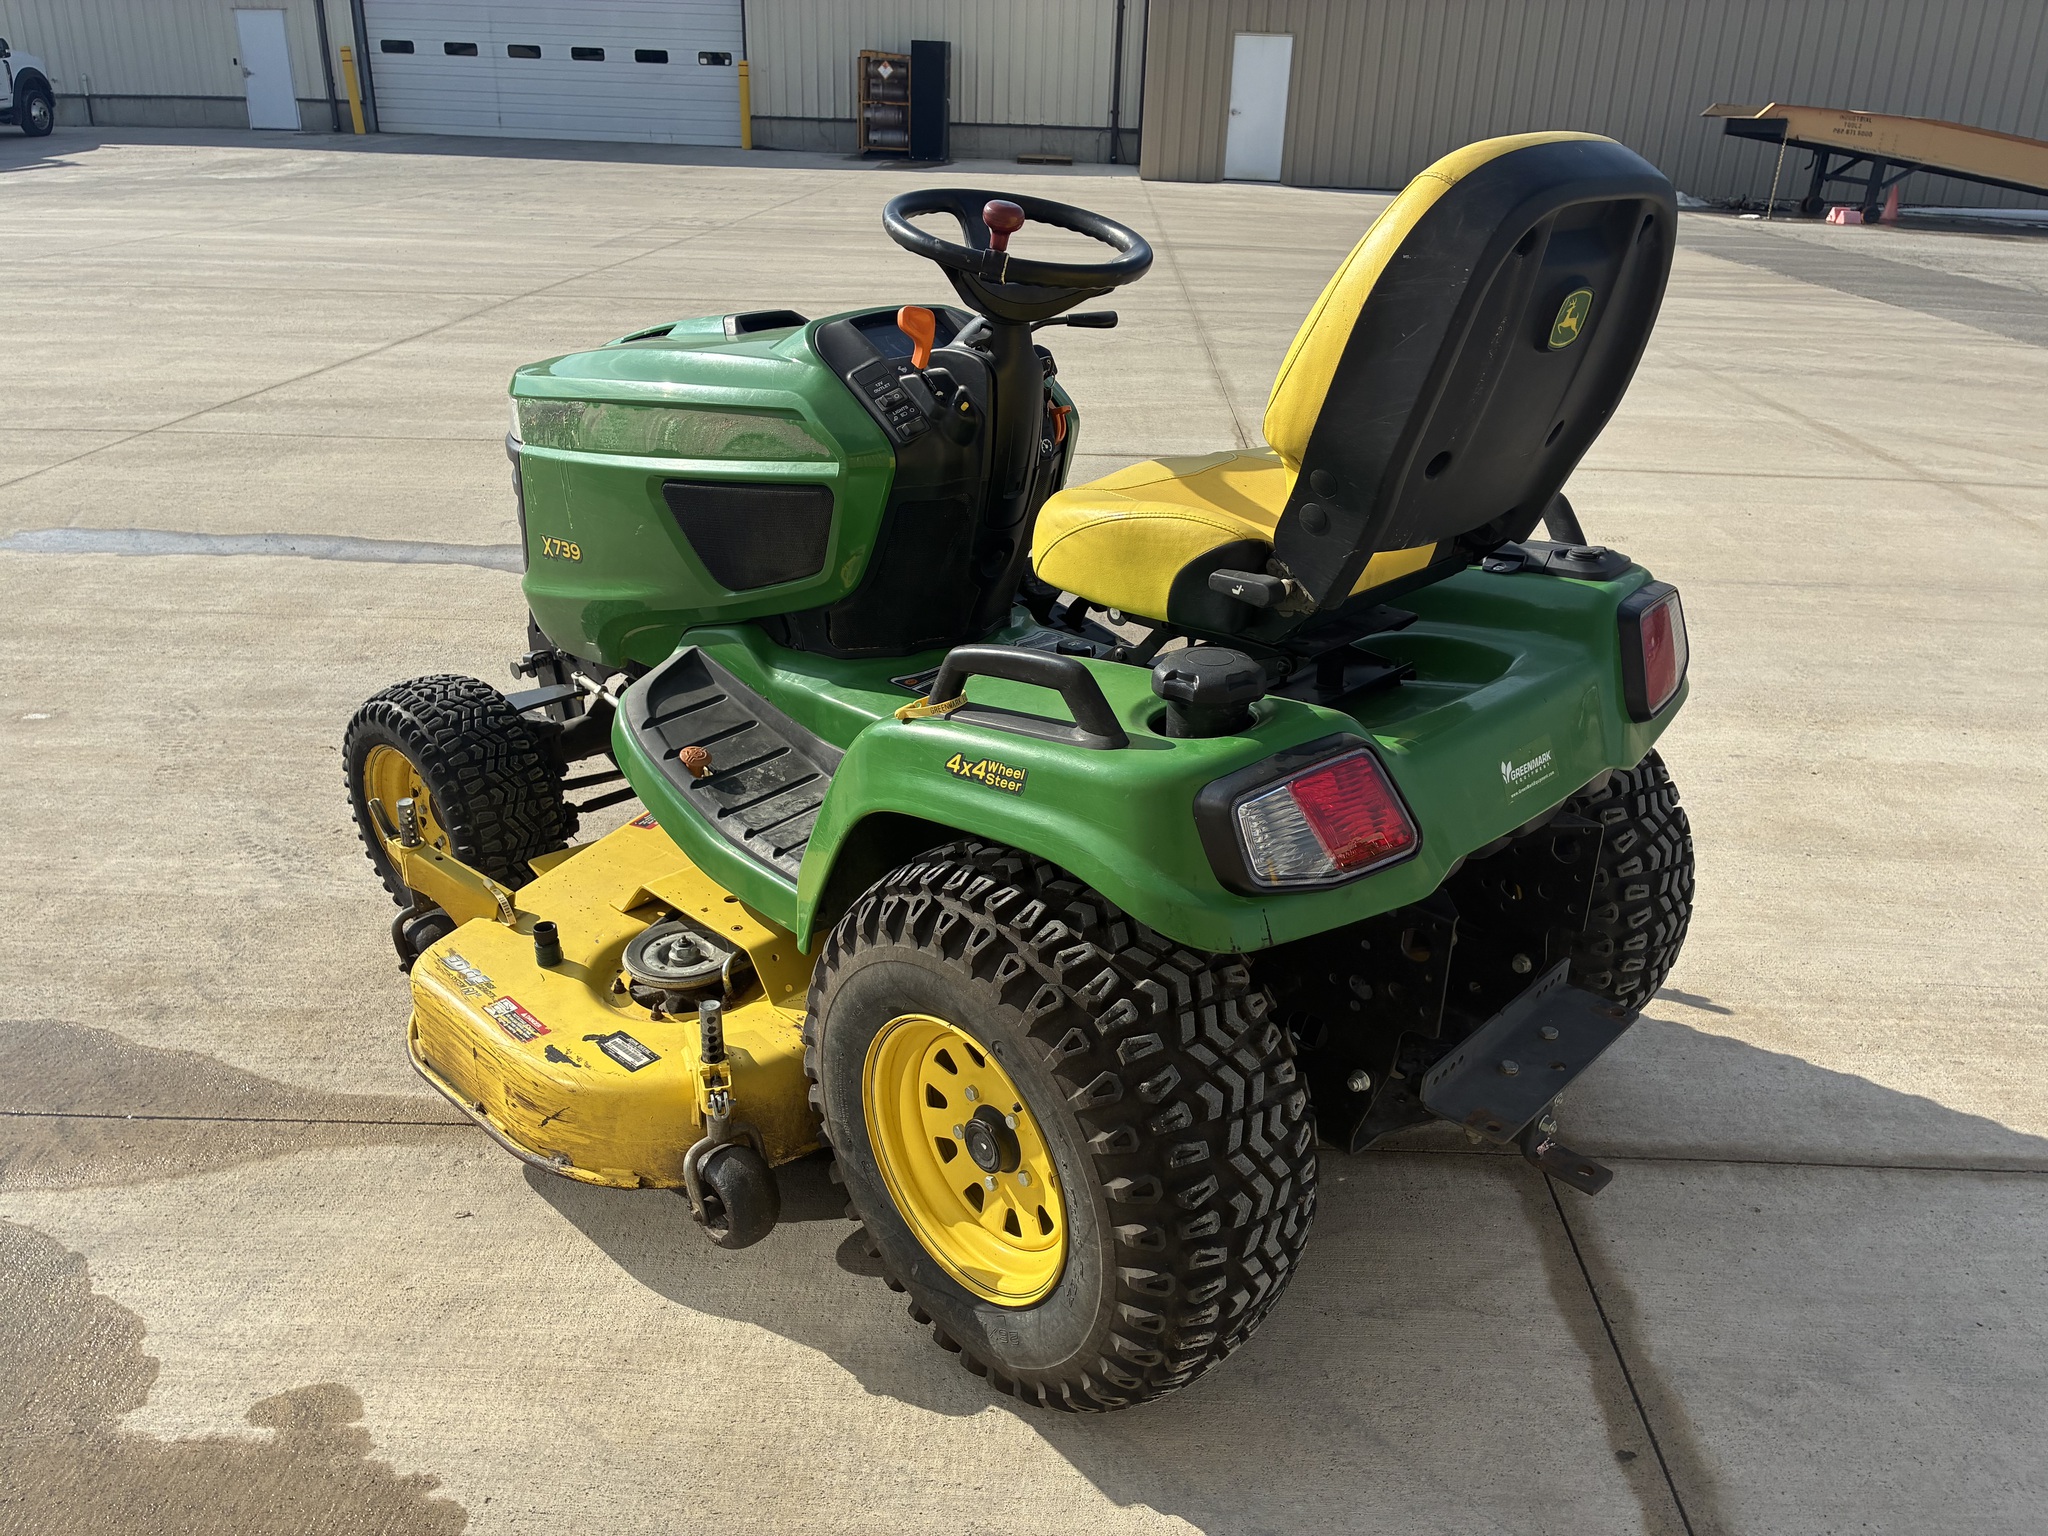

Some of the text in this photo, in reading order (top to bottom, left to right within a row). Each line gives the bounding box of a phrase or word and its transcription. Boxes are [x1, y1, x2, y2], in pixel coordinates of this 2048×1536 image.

[873, 383, 891, 394] OUTLET
[892, 405, 908, 416] LIGHTS
[541, 535, 581, 560] X739
[930, 696, 961, 714] GREENMARK
[946, 753, 988, 780] 4x4
[988, 760, 1026, 780] Wheel
[1510, 750, 1551, 781] GREENMARK
[1515, 762, 1550, 785] EQUIPMENT
[985, 773, 1022, 792] Steer
